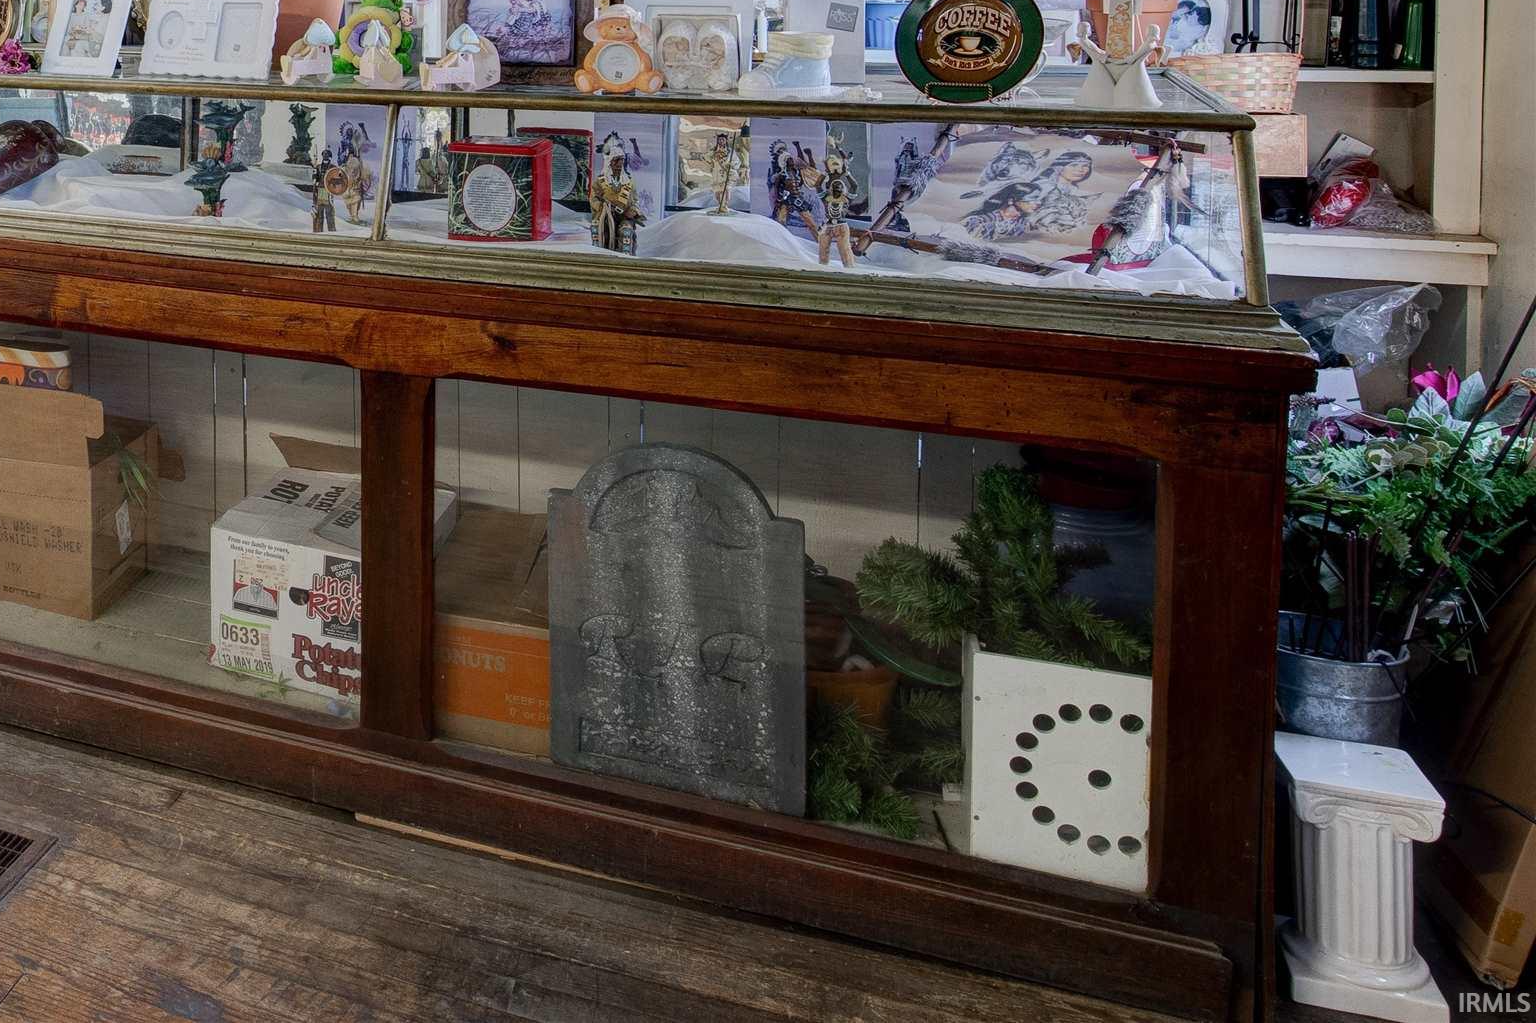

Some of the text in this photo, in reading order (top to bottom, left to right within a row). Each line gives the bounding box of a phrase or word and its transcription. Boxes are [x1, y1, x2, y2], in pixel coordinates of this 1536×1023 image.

[934, 5, 1012, 37] COFFEE
[44, 538, 82, 554] WASHER
[227, 535, 241, 544] From
[330, 561, 353, 573] BEYOND
[221, 622, 260, 647] 0633
[222, 653, 274, 674] 13 MAY 2019
[504, 692, 537, 706] KEEP
